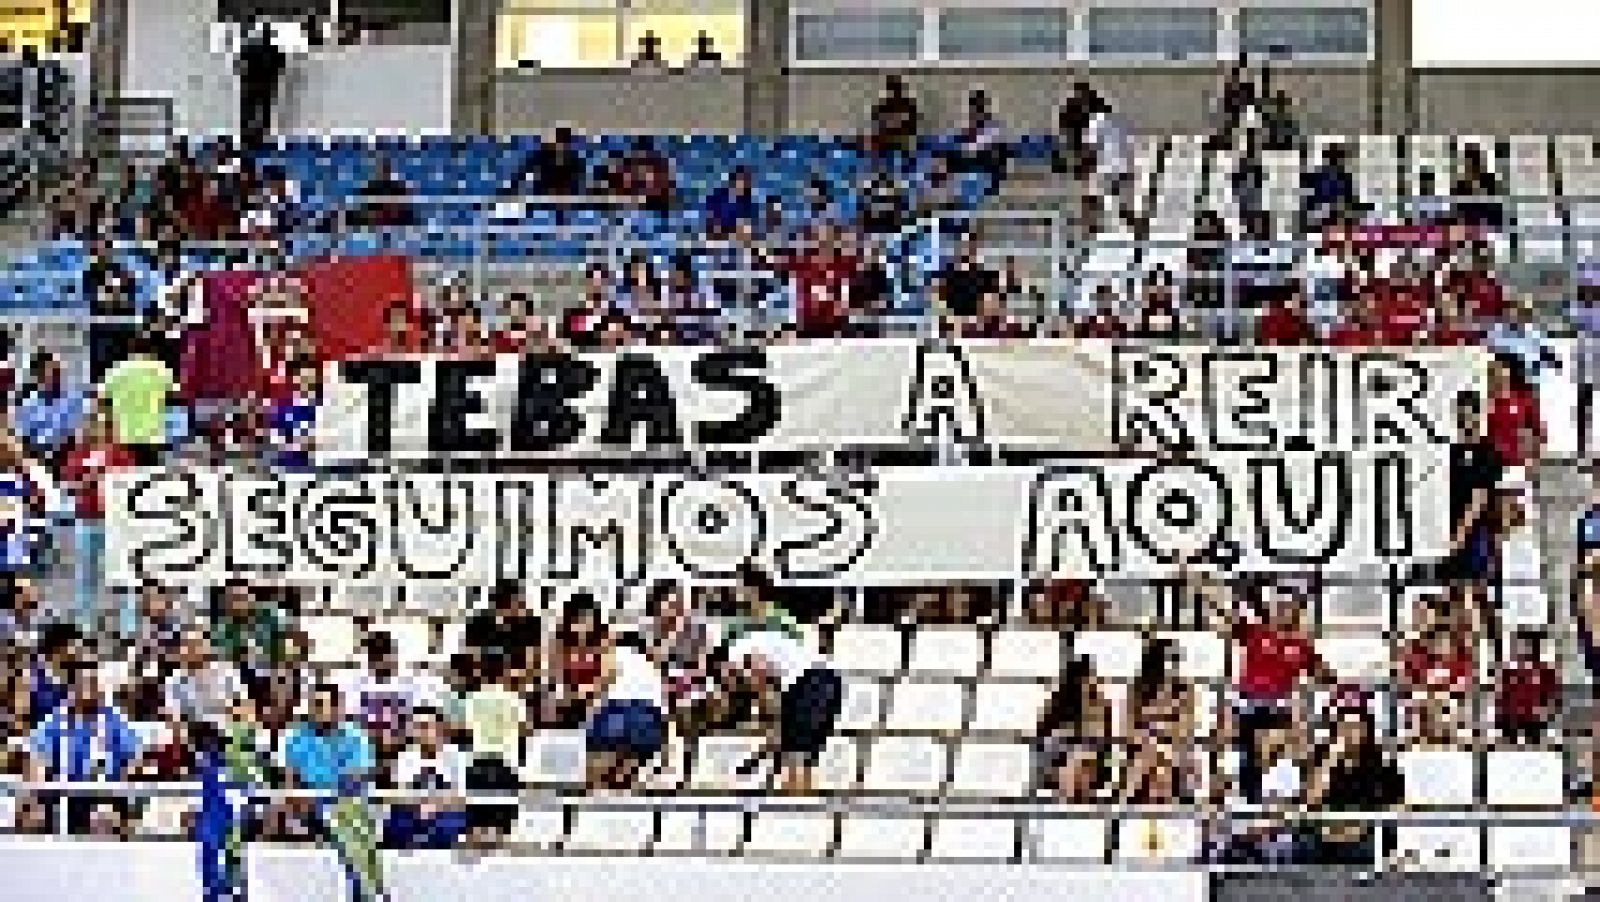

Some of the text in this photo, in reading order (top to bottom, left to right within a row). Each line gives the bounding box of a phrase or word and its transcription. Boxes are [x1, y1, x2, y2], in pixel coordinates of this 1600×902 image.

[345, 342, 1448, 452] TEBAS A REIR
[126, 470, 880, 585] SEGUIMOS
